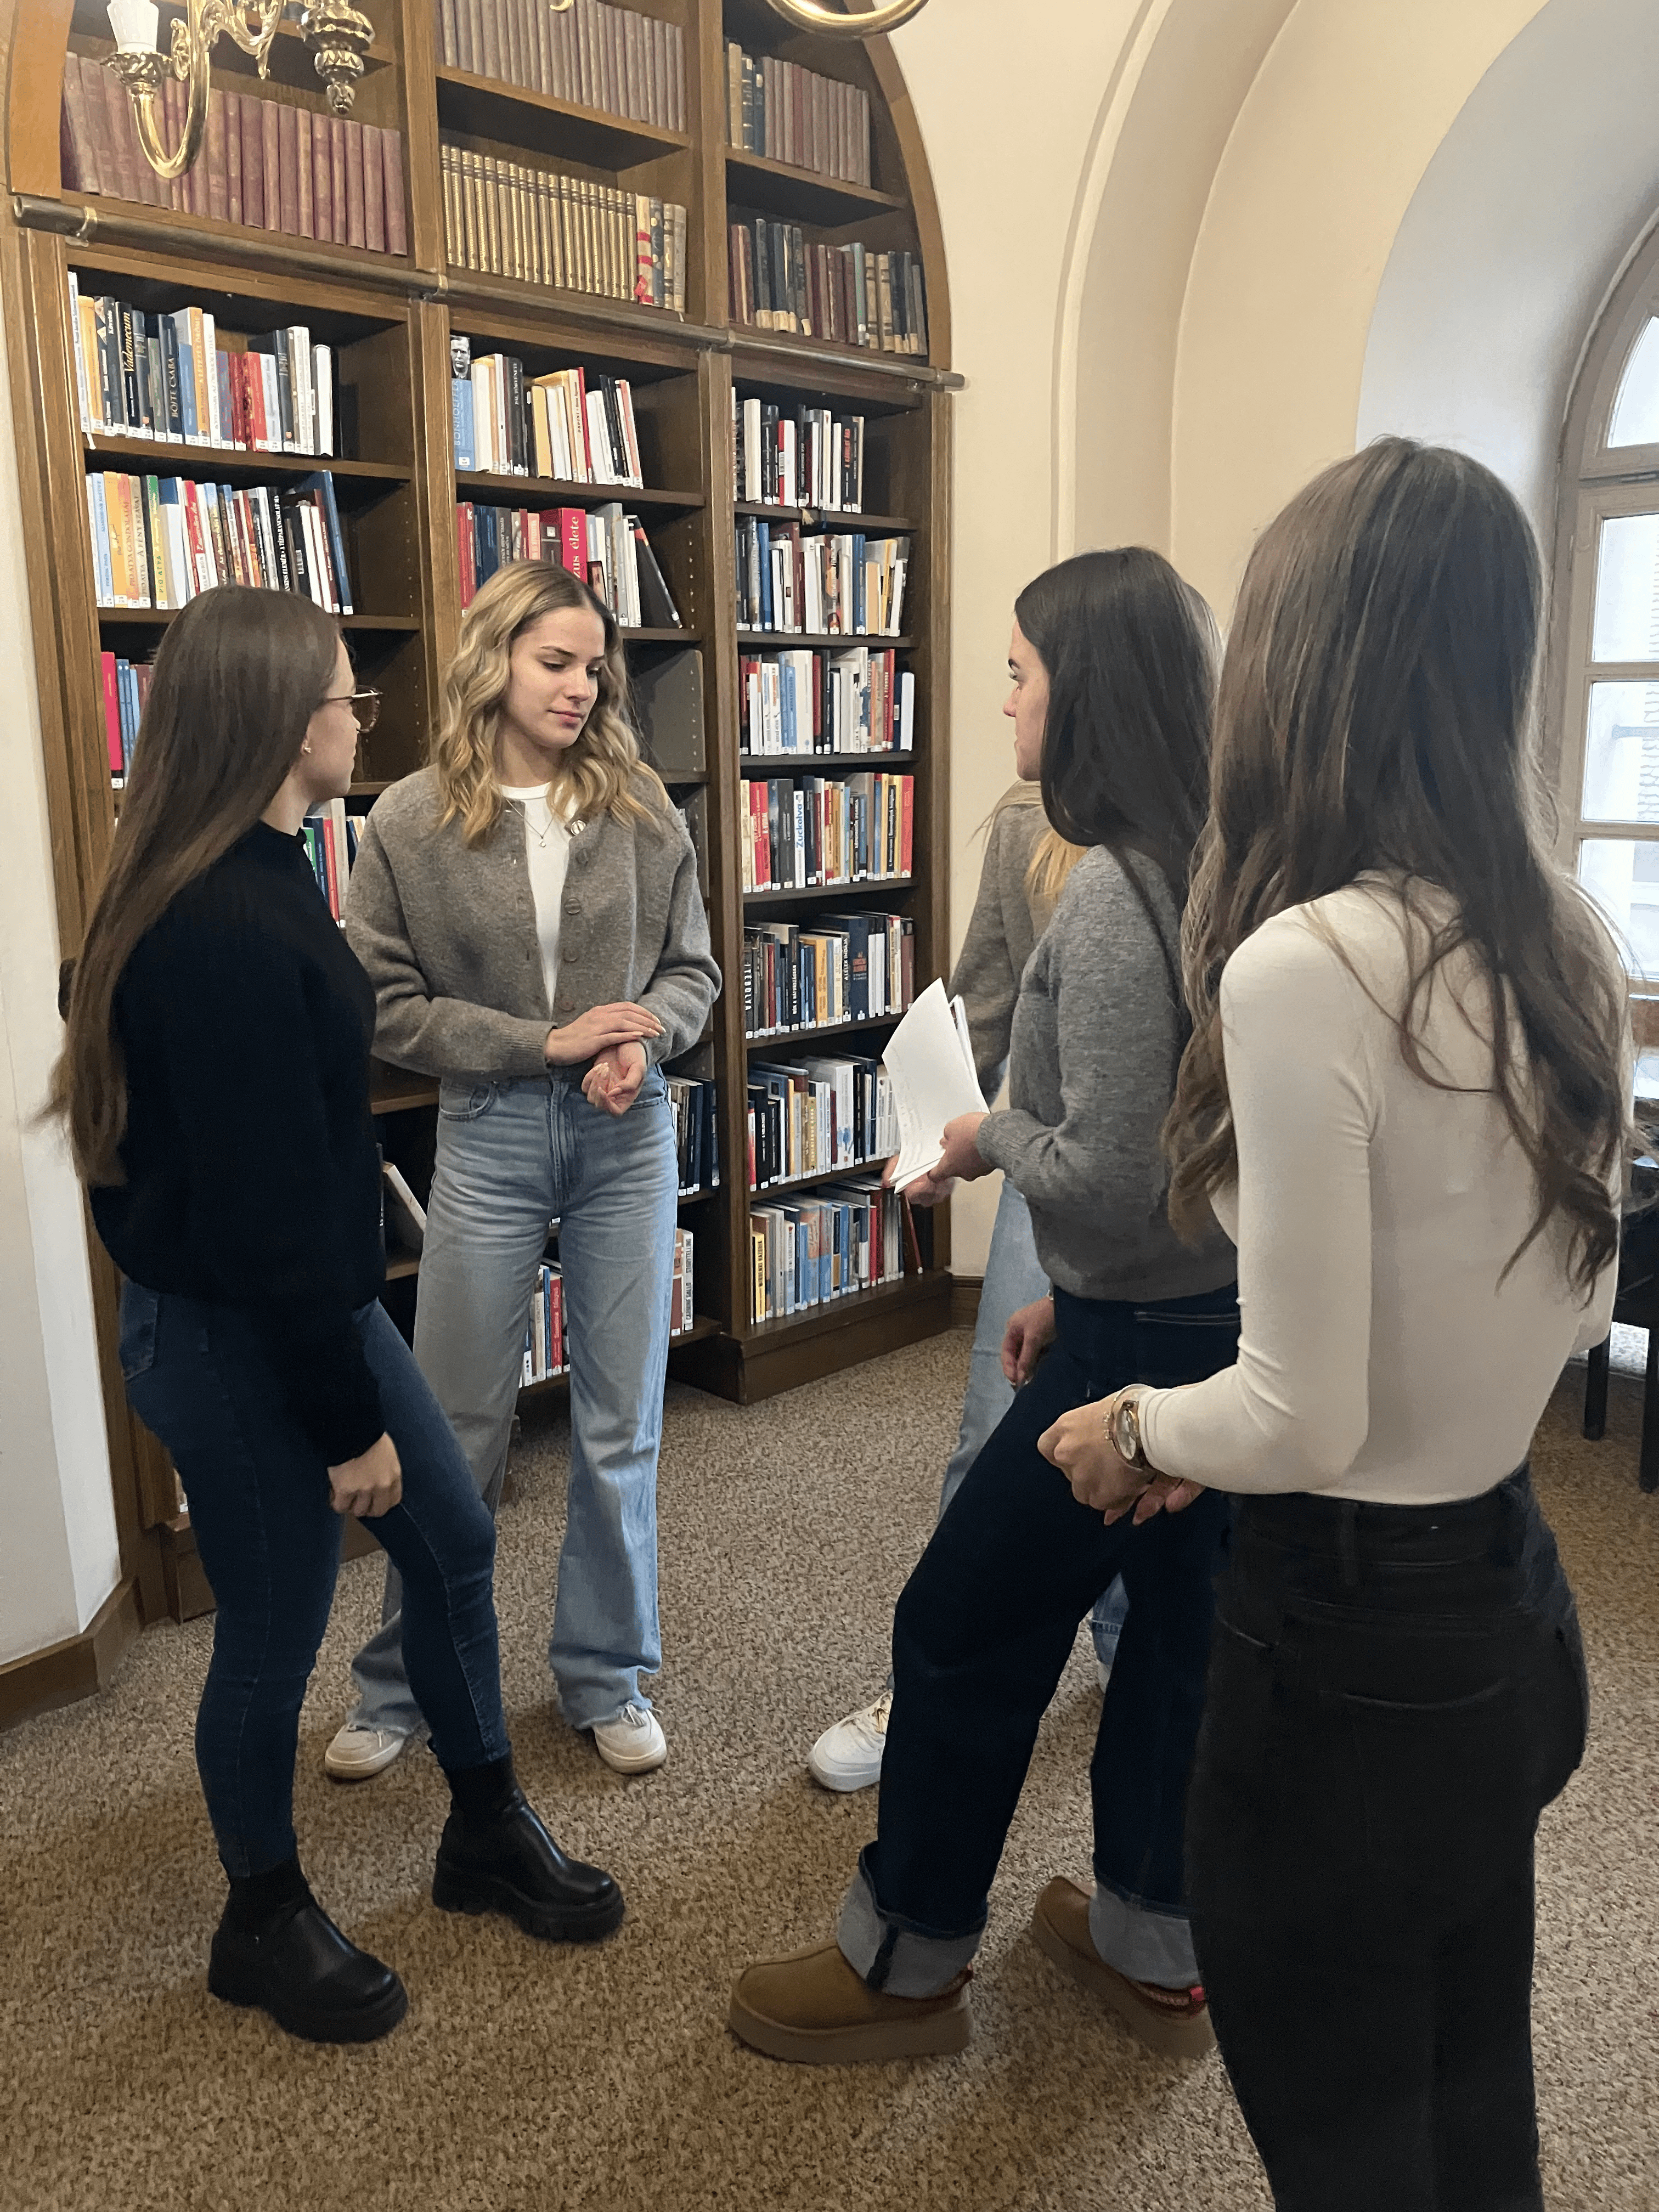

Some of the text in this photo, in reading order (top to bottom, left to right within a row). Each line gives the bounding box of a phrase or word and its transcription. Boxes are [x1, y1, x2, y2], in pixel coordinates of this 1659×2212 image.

[122, 312, 134, 372] Vademecum
[452, 380, 461, 445] BONHOEFFER
[568, 516, 580, 579] zus élete
[795, 804, 804, 848] Zuckolva
